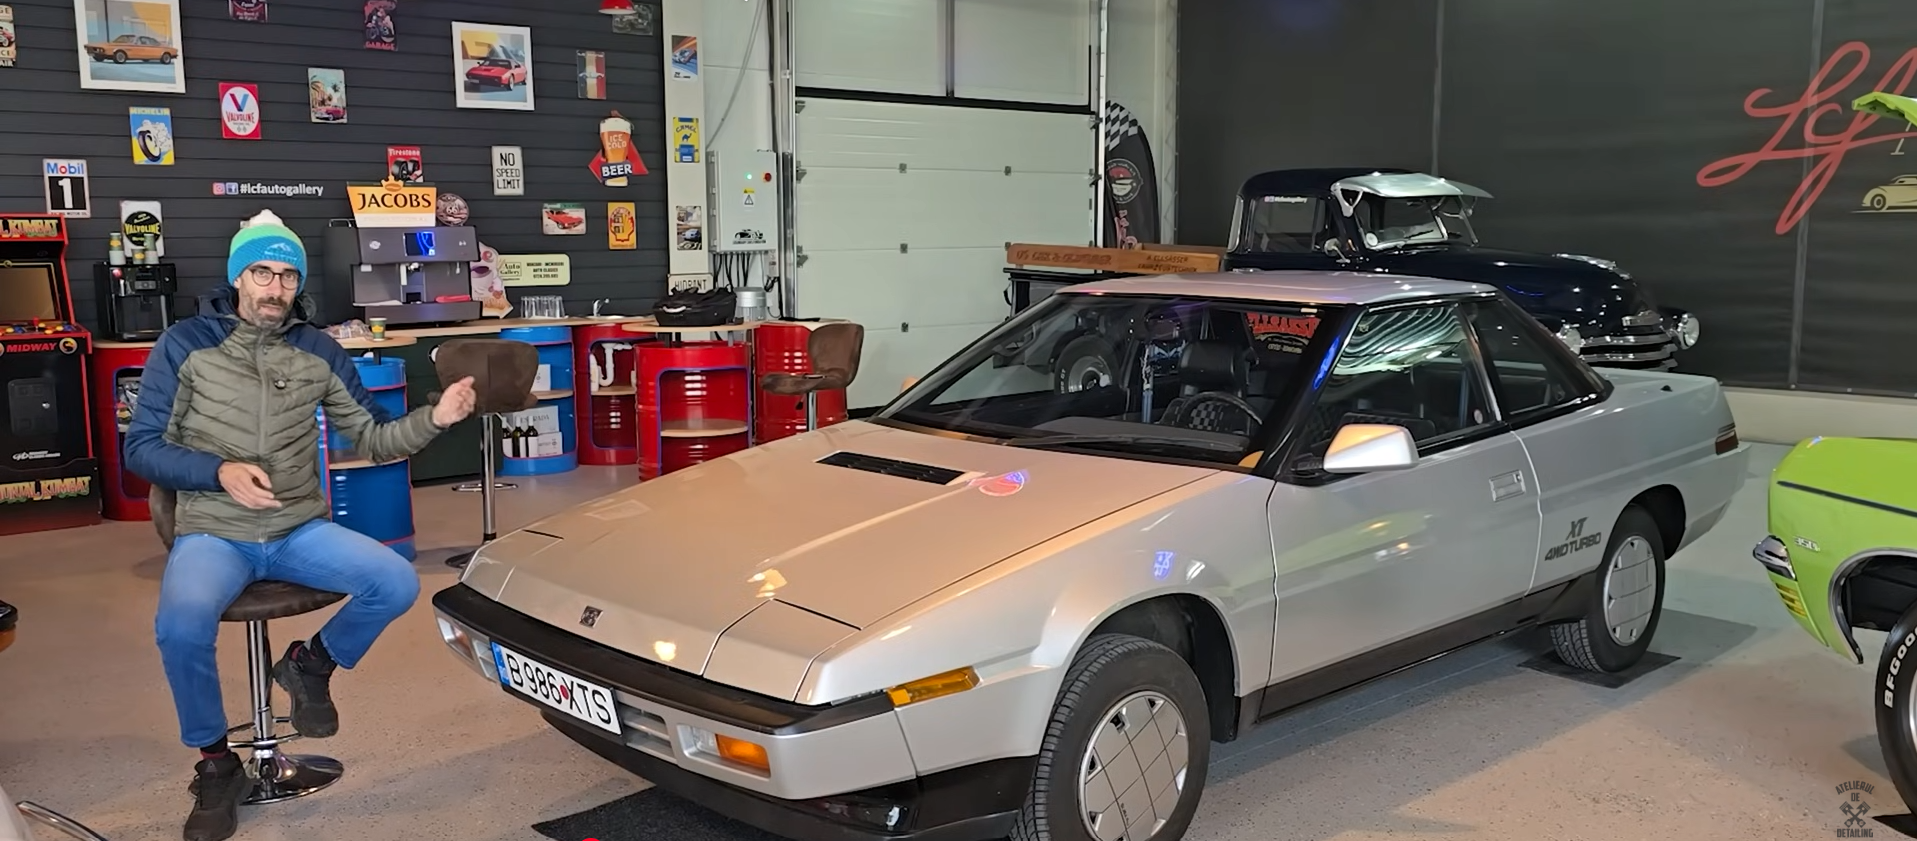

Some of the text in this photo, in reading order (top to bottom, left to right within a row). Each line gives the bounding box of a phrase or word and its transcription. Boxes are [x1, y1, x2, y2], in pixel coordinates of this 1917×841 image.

[226, 111, 255, 124] VALVOLINE
[676, 124, 697, 133] CAMEL
[609, 134, 623, 142] ICE
[607, 141, 627, 149] COLD
[387, 148, 420, 157] Firestone
[500, 153, 515, 166] NO
[47, 162, 85, 175] Mobil
[496, 168, 521, 178] SPEED
[601, 163, 633, 178] BEER
[496, 179, 521, 189] LIMIT
[58, 177, 74, 209] 1
[357, 193, 432, 210] JACOBS
[125, 222, 161, 235] VALVOLINE
[6, 342, 58, 352] MIDWAY
[1565, 516, 1589, 541] XT
[1544, 532, 1601, 561] 4WD TURBO
[1884, 626, 1917, 708] BFGOO
[506, 653, 612, 725] B 986 XTS
